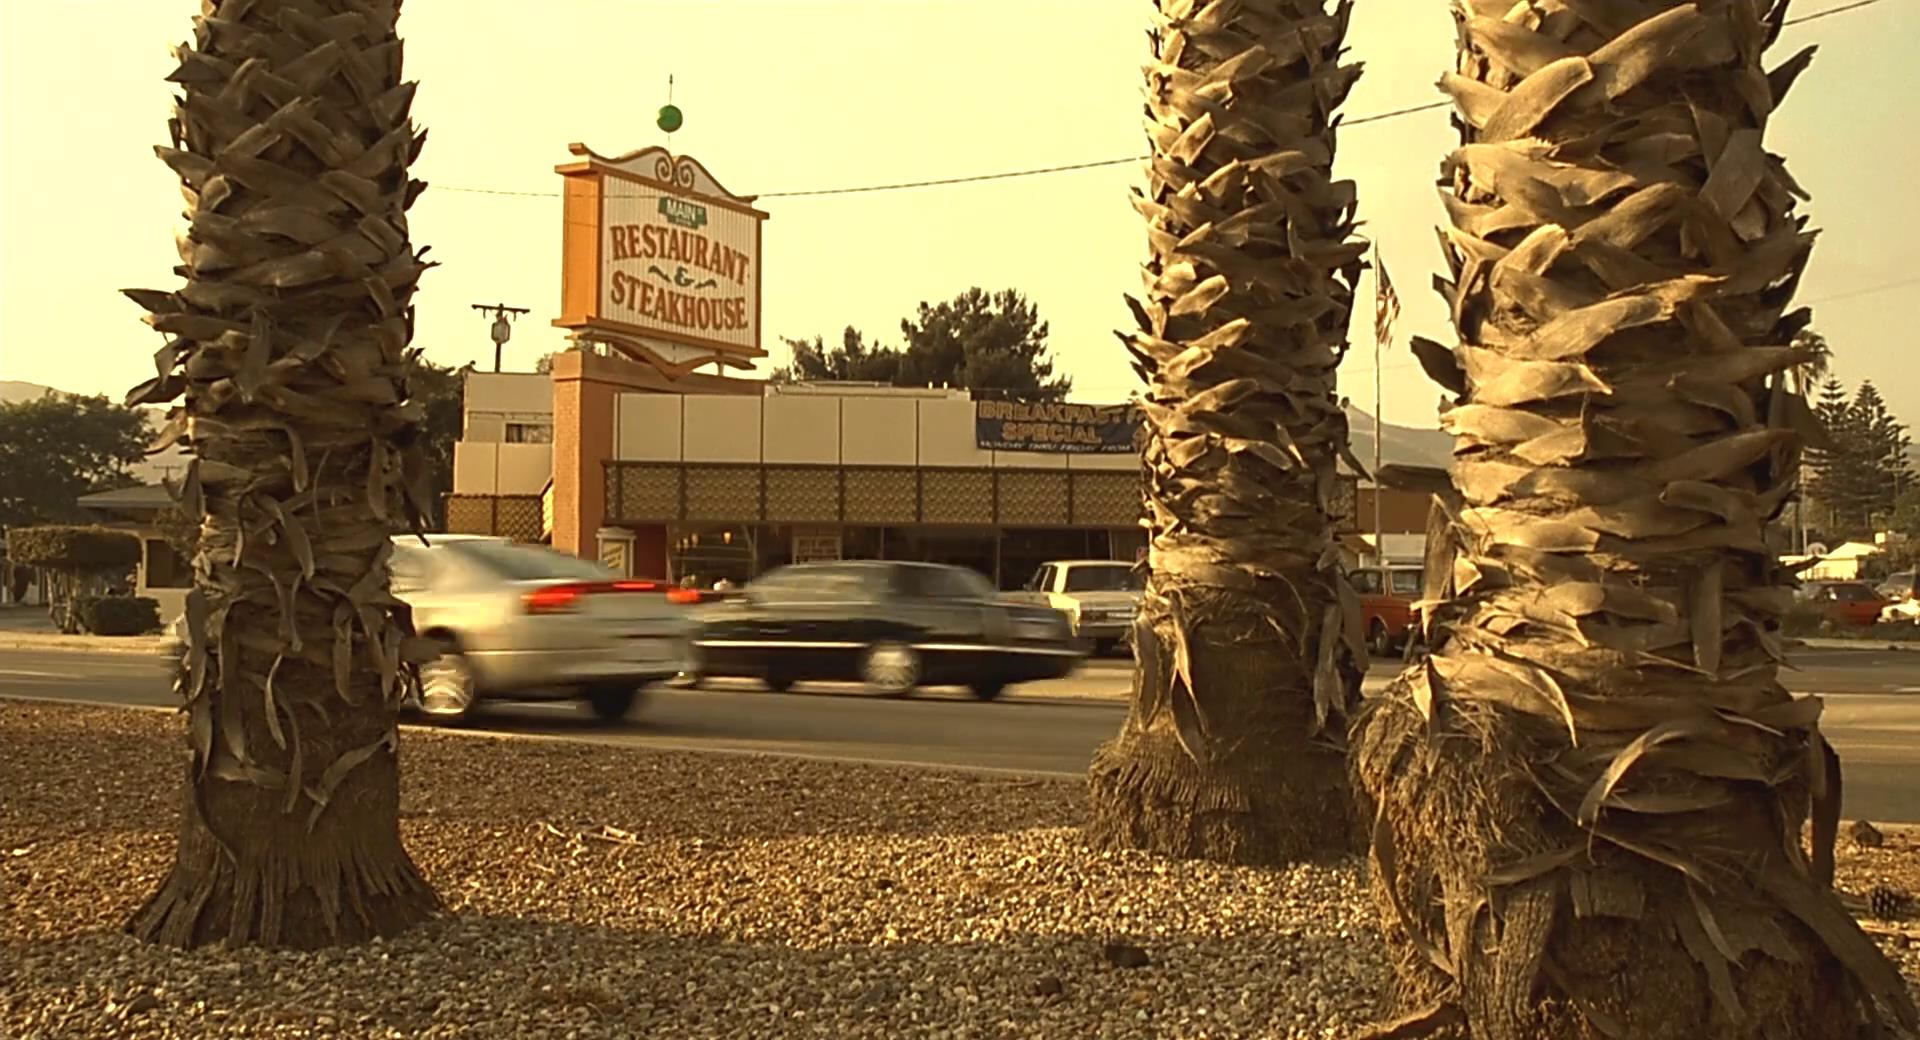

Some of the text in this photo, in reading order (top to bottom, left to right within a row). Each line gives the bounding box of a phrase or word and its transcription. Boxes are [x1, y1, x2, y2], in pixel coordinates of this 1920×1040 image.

[666, 199, 696, 221] MAIN
[610, 224, 750, 286] RESTAURANT
[674, 266, 695, 287] &
[611, 269, 748, 331] STEAKHOUSE
[979, 400, 1124, 424] BREAKFAST
[1002, 422, 1102, 444] SPECIAL
